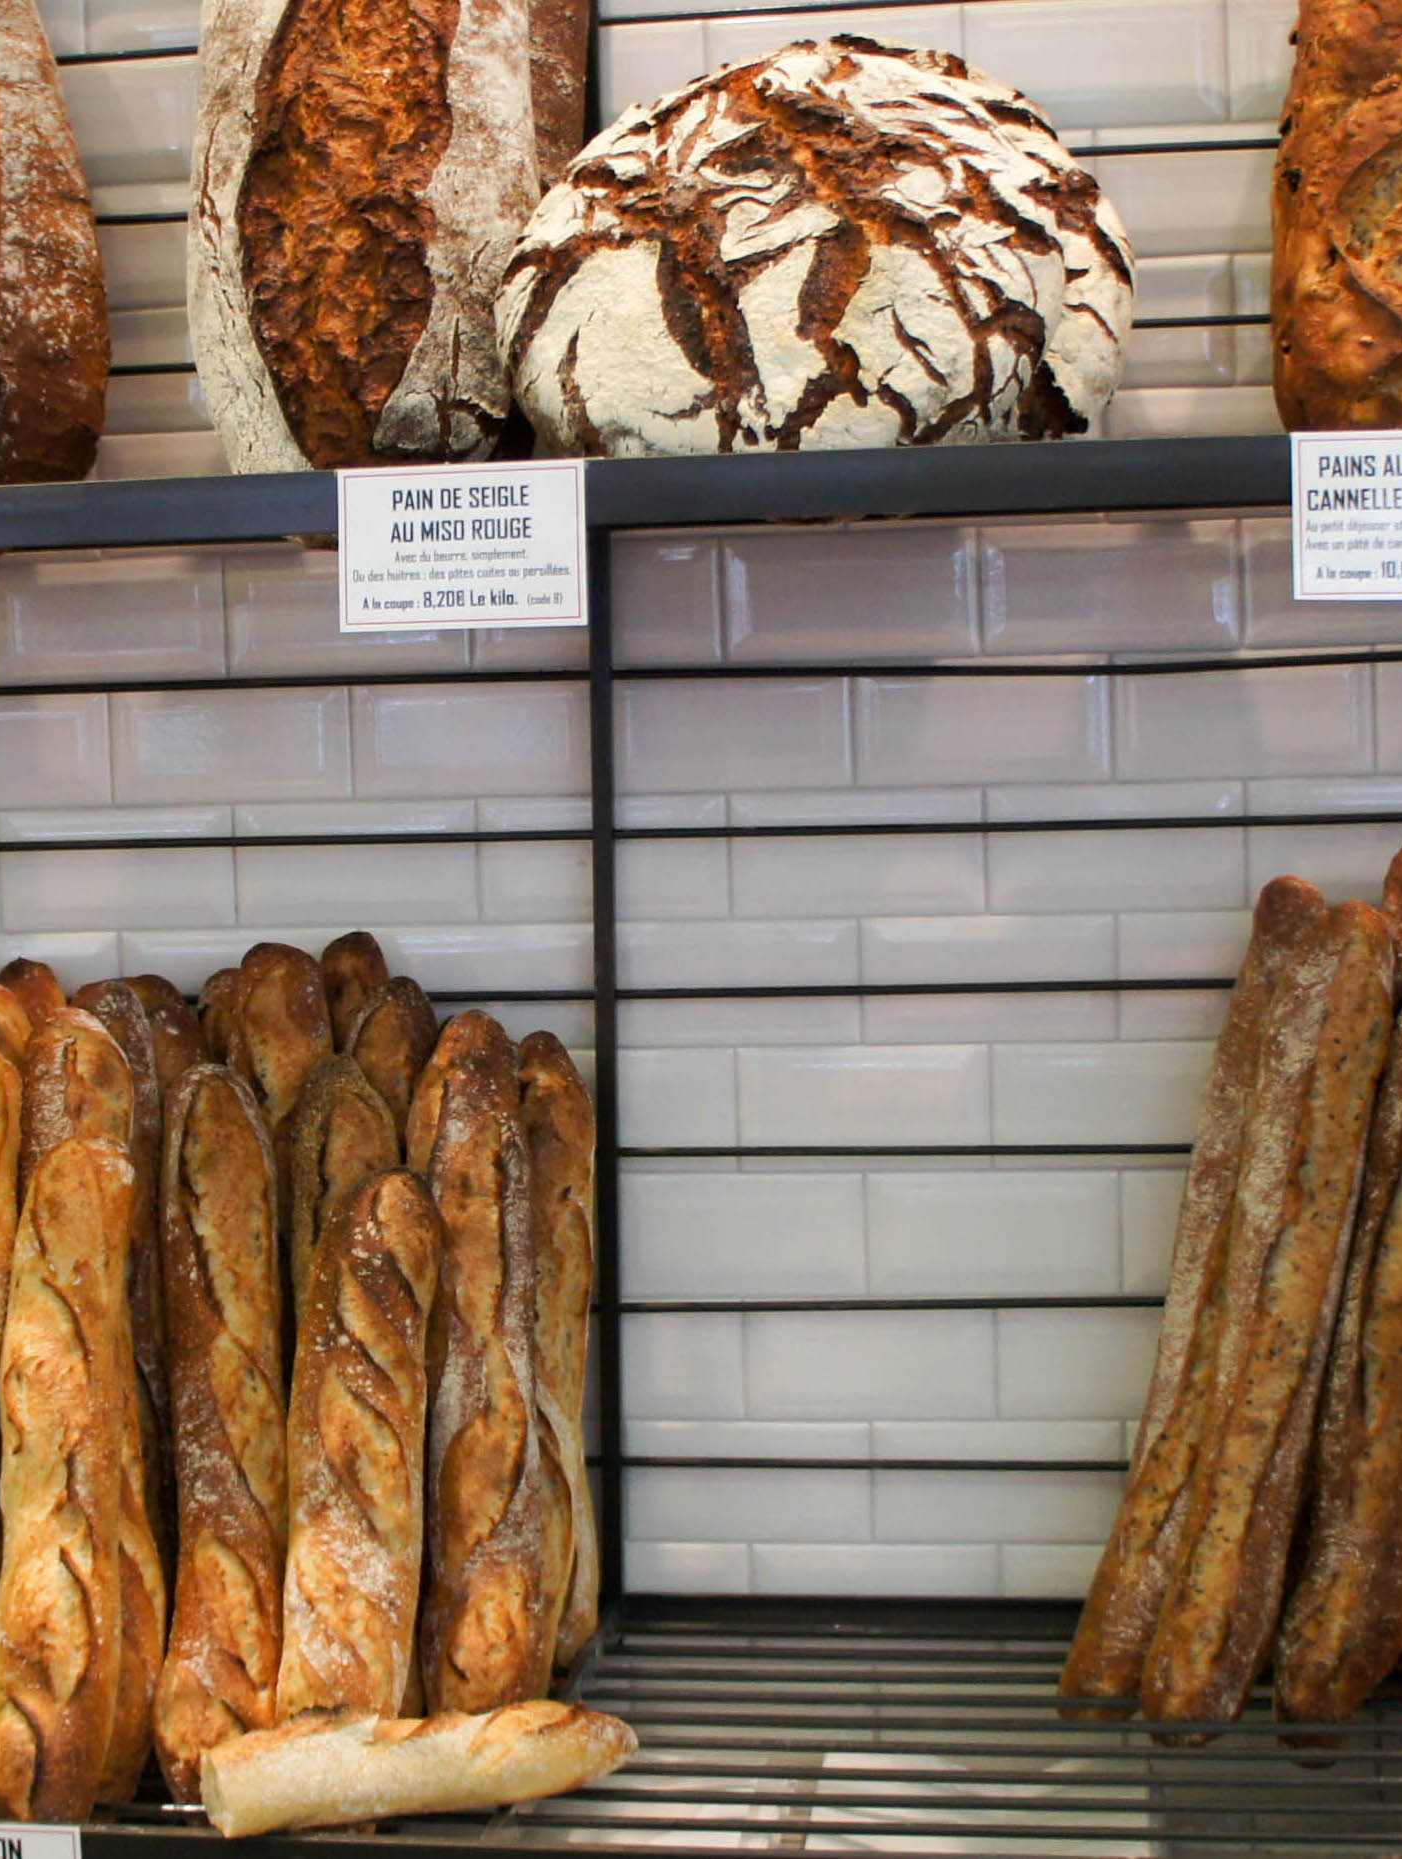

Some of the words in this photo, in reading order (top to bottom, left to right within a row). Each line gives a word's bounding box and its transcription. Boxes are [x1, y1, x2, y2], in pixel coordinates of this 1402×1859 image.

[1319, 456, 1375, 477] PAINS
[392, 489, 433, 511] PAIN
[441, 488, 462, 509] DE
[469, 485, 529, 508] SEIGLE
[391, 522, 413, 543] AU
[421, 520, 464, 541] MISO
[472, 517, 532, 540] ROUGE
[395, 552, 416, 563] Avec
[420, 551, 431, 562] du
[353, 571, 365, 582] Ou
[368, 571, 383, 582] des
[429, 568, 445, 579] des
[1316, 567, 1323, 579] A
[1327, 567, 1336, 578] la
[1339, 568, 1372, 580] coupe
[362, 598, 368, 609] A
[372, 597, 381, 608] la
[384, 599, 414, 610] coupe
[423, 591, 464, 609] 8,20€
[470, 590, 485, 606] Le
[490, 589, 518, 605] kilo.
